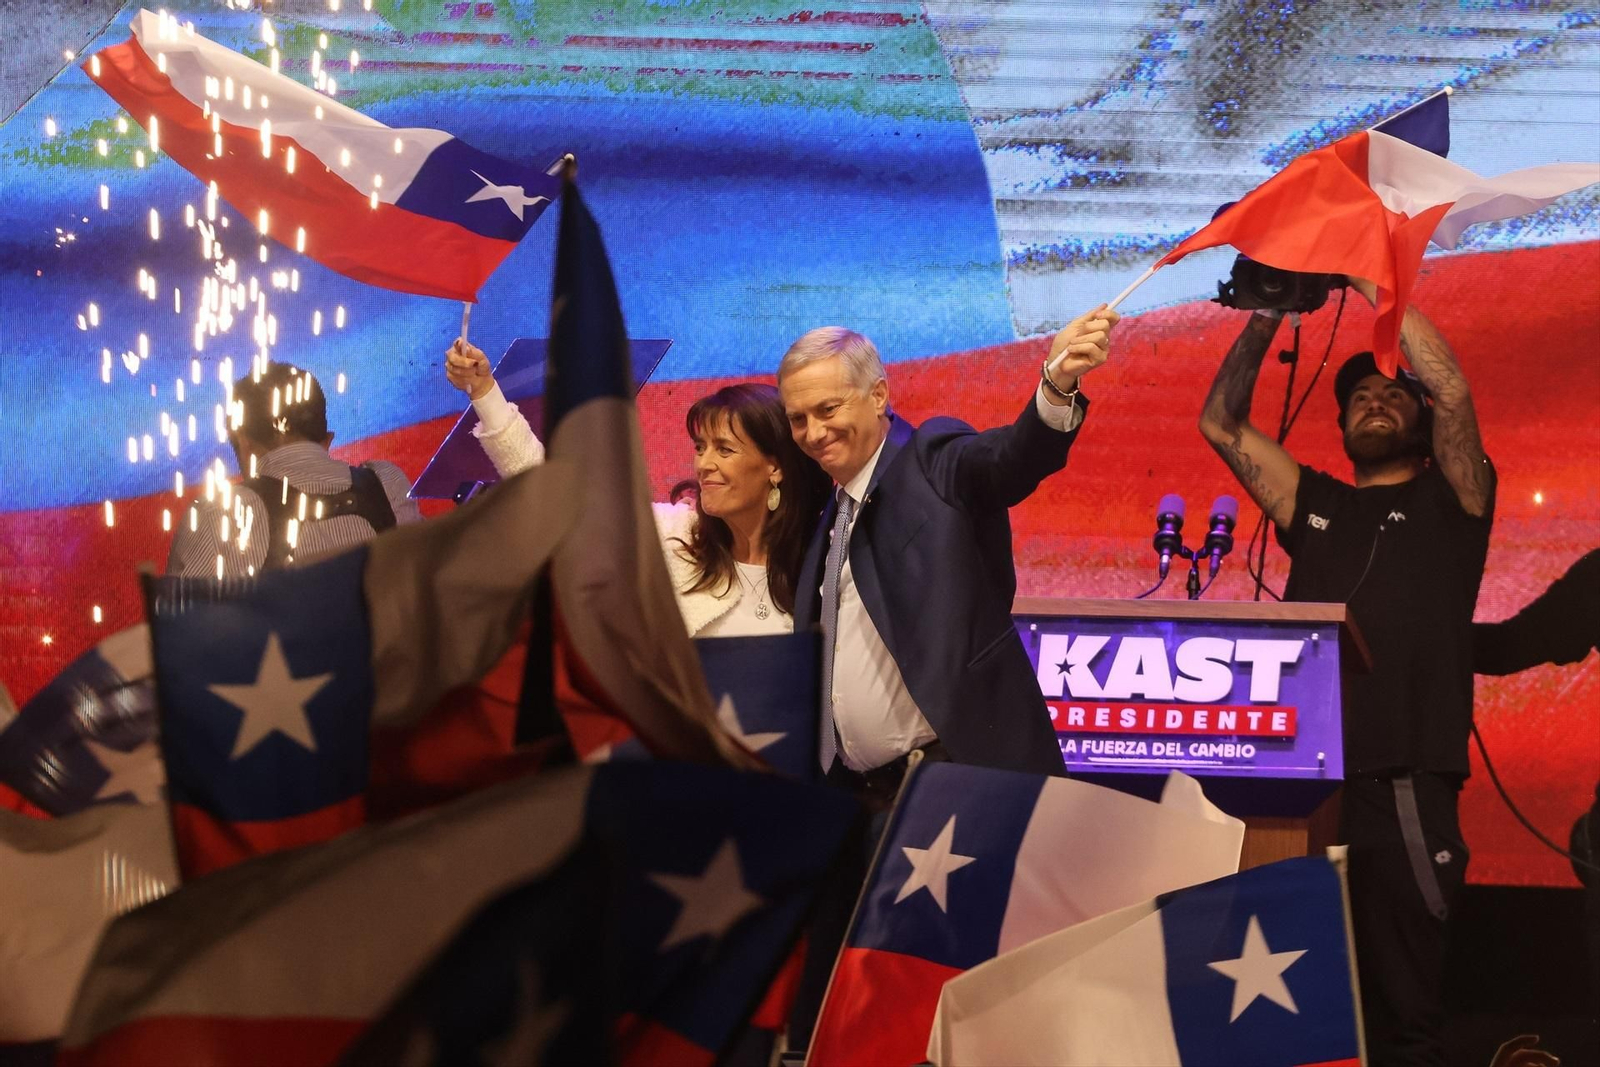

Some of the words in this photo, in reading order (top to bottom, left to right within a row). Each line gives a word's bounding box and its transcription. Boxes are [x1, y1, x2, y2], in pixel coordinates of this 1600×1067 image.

[1037, 634, 1305, 702] KAST
[1081, 740, 1147, 756] FUERZA
[1152, 742, 1185, 756] DEL
[1189, 743, 1256, 758] CAMBIO
